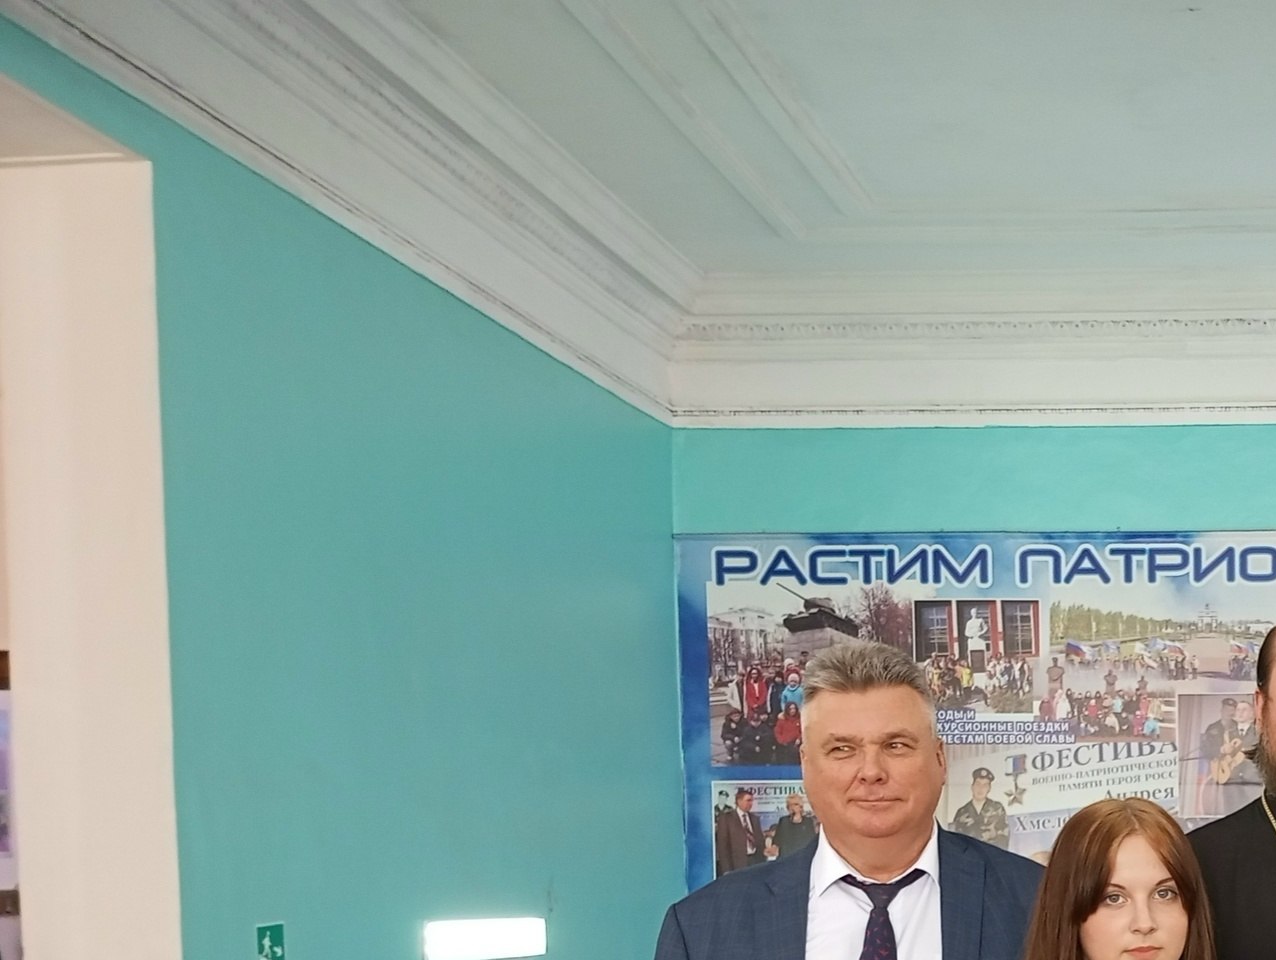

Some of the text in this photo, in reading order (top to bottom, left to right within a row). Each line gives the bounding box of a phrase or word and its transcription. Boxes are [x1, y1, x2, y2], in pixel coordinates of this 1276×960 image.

[714, 547, 989, 586] РАСТИМ
[935, 710, 975, 720] ОДЫ И
[1016, 721, 1070, 732] ПОЕЗДКИ
[987, 732, 1032, 743] БОЕВОЙ
[1035, 734, 1075, 744] СЛАВЫ
[1058, 780, 1102, 792] ПАМЯТИ
[1106, 775, 1141, 787] ГЕРОЯ
